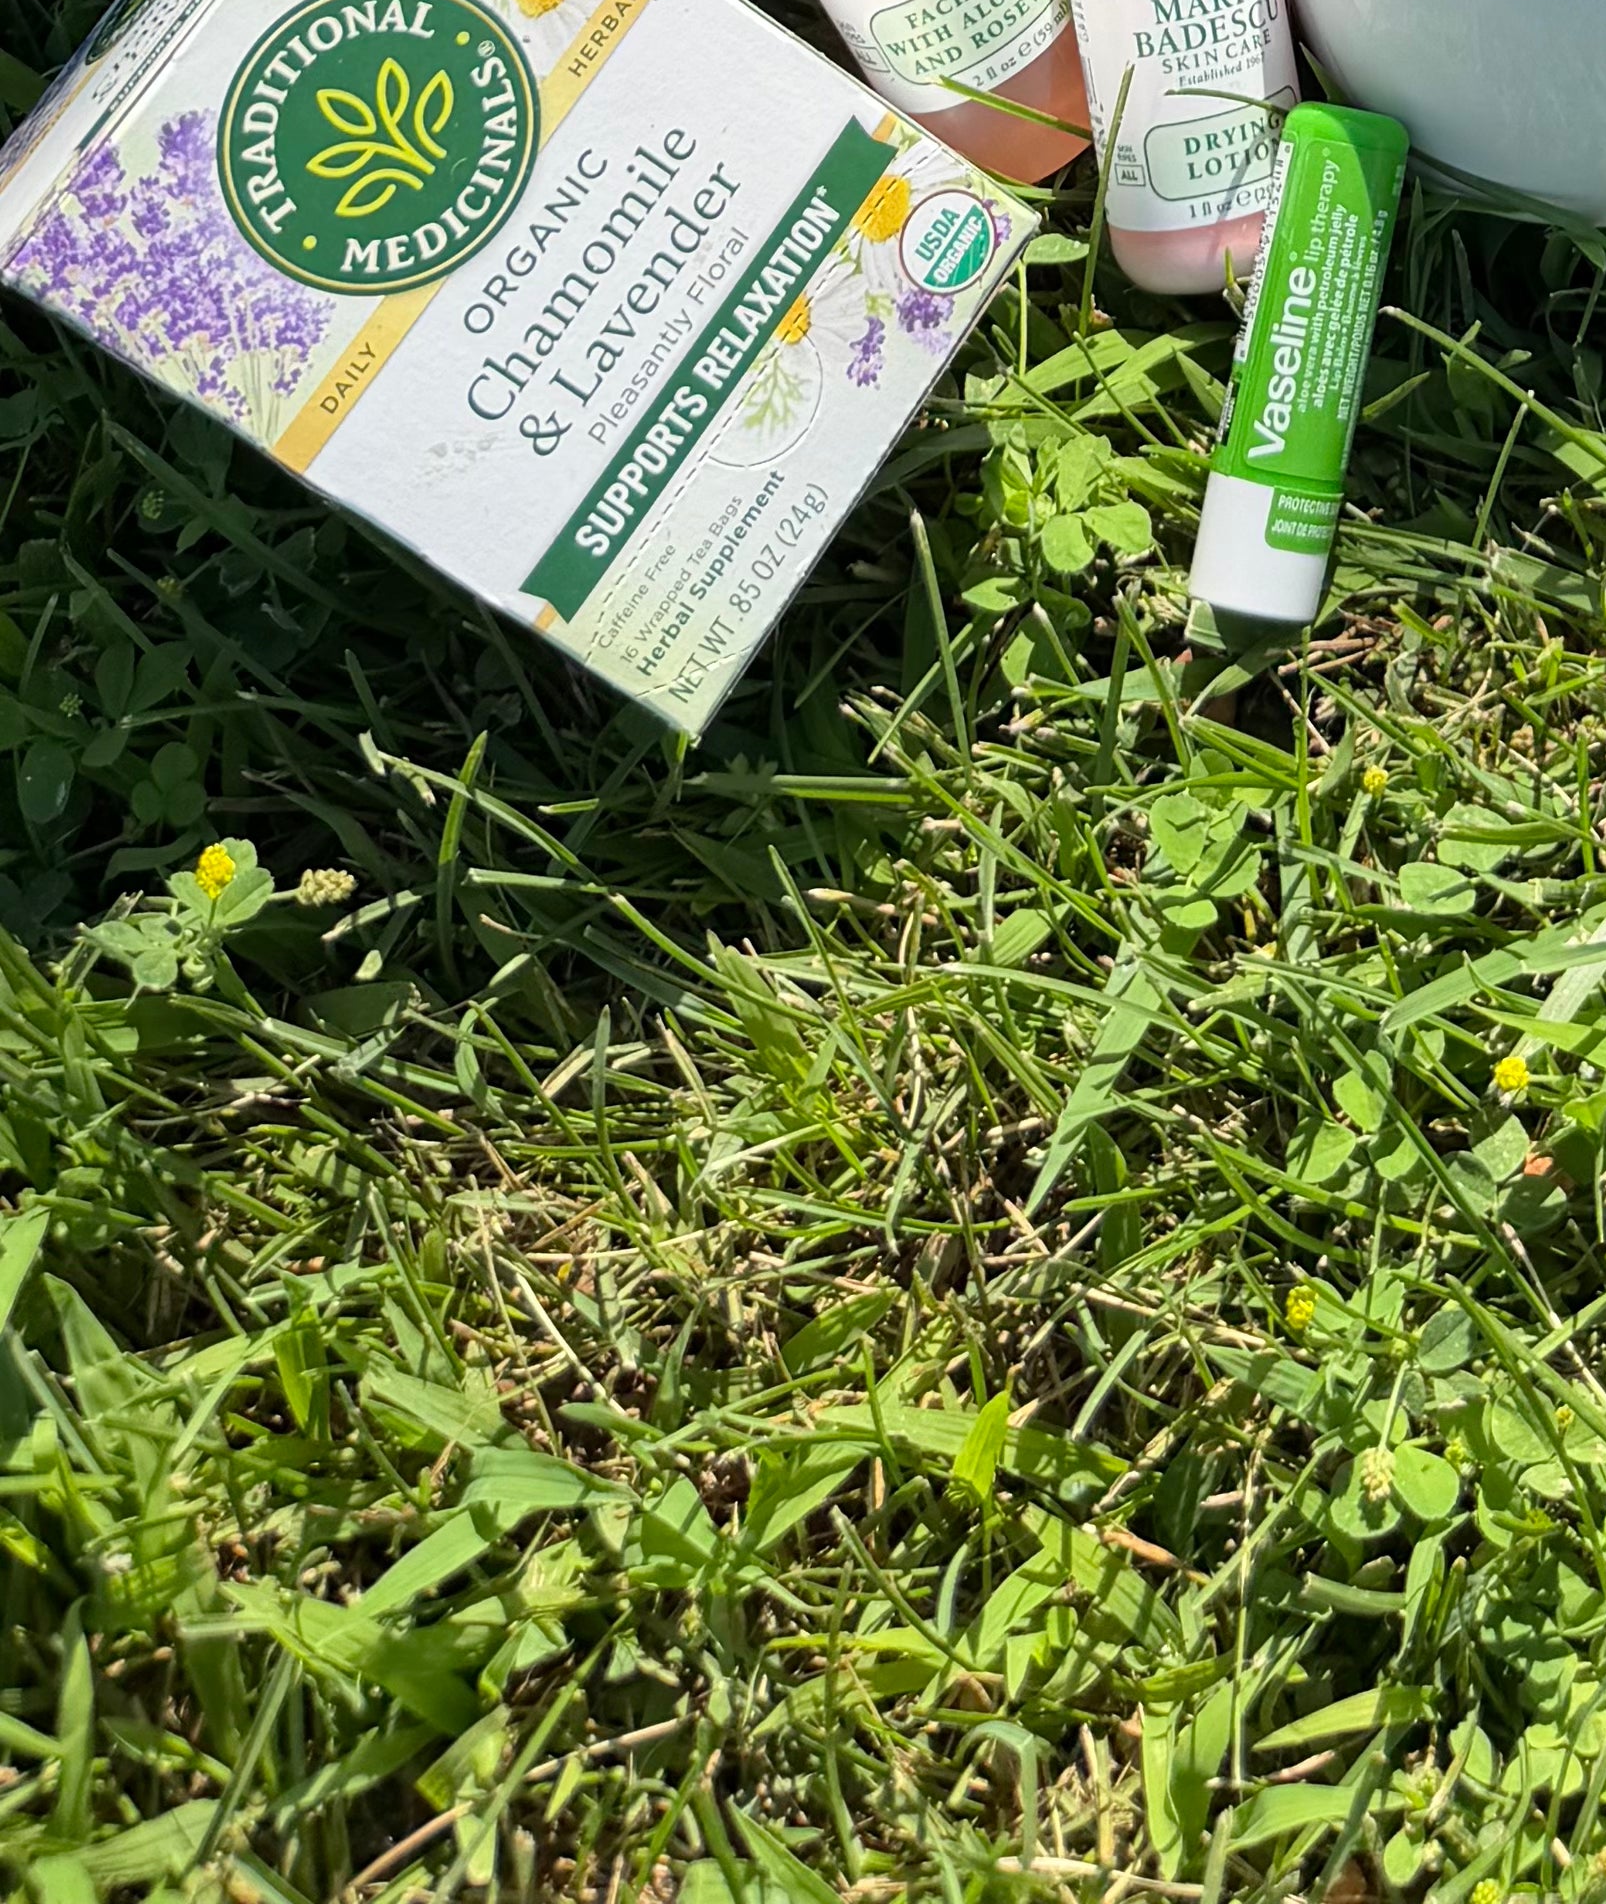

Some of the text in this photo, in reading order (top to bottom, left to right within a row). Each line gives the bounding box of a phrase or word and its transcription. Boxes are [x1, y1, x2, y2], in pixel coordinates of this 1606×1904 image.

[885, 24, 953, 57] WITH
[914, 46, 963, 76] AND
[973, 75, 982, 87] 2
[986, 66, 998, 80] fl
[1001, 57, 1017, 73] oz
[1033, 22, 1053, 48] (59
[1162, 28, 1272, 75] SKIN CARE
[1179, 60, 1243, 88] Established
[1184, 112, 1280, 157] DRYING
[463, 148, 608, 334] ORGANIC
[914, 208, 960, 261] USDA
[1189, 204, 1196, 219] 1
[1202, 201, 1211, 217] fl
[1217, 201, 1233, 214] oz
[1340, 214, 1359, 269] pétrole
[467, 127, 696, 421] Chamomile
[933, 215, 983, 283] ORGANIC
[1303, 236, 1325, 262] lip
[1334, 269, 1347, 287] de
[519, 161, 741, 457] & Lavender
[587, 226, 749, 446] Pleasantly Floral
[1297, 203, 1348, 414] aloe vera with petroleum jelly
[320, 342, 378, 414] DAILY
[1322, 333, 1336, 368] avec
[1312, 368, 1330, 409] aloès
[575, 385, 708, 558] SUPPORTS
[599, 544, 676, 649] Caffeine Free
[620, 496, 742, 664] 16 Wrapped Tea Bags
[636, 469, 786, 677] Herbal Supplement
[668, 483, 829, 704] NET WT .85 OZ (24g)
